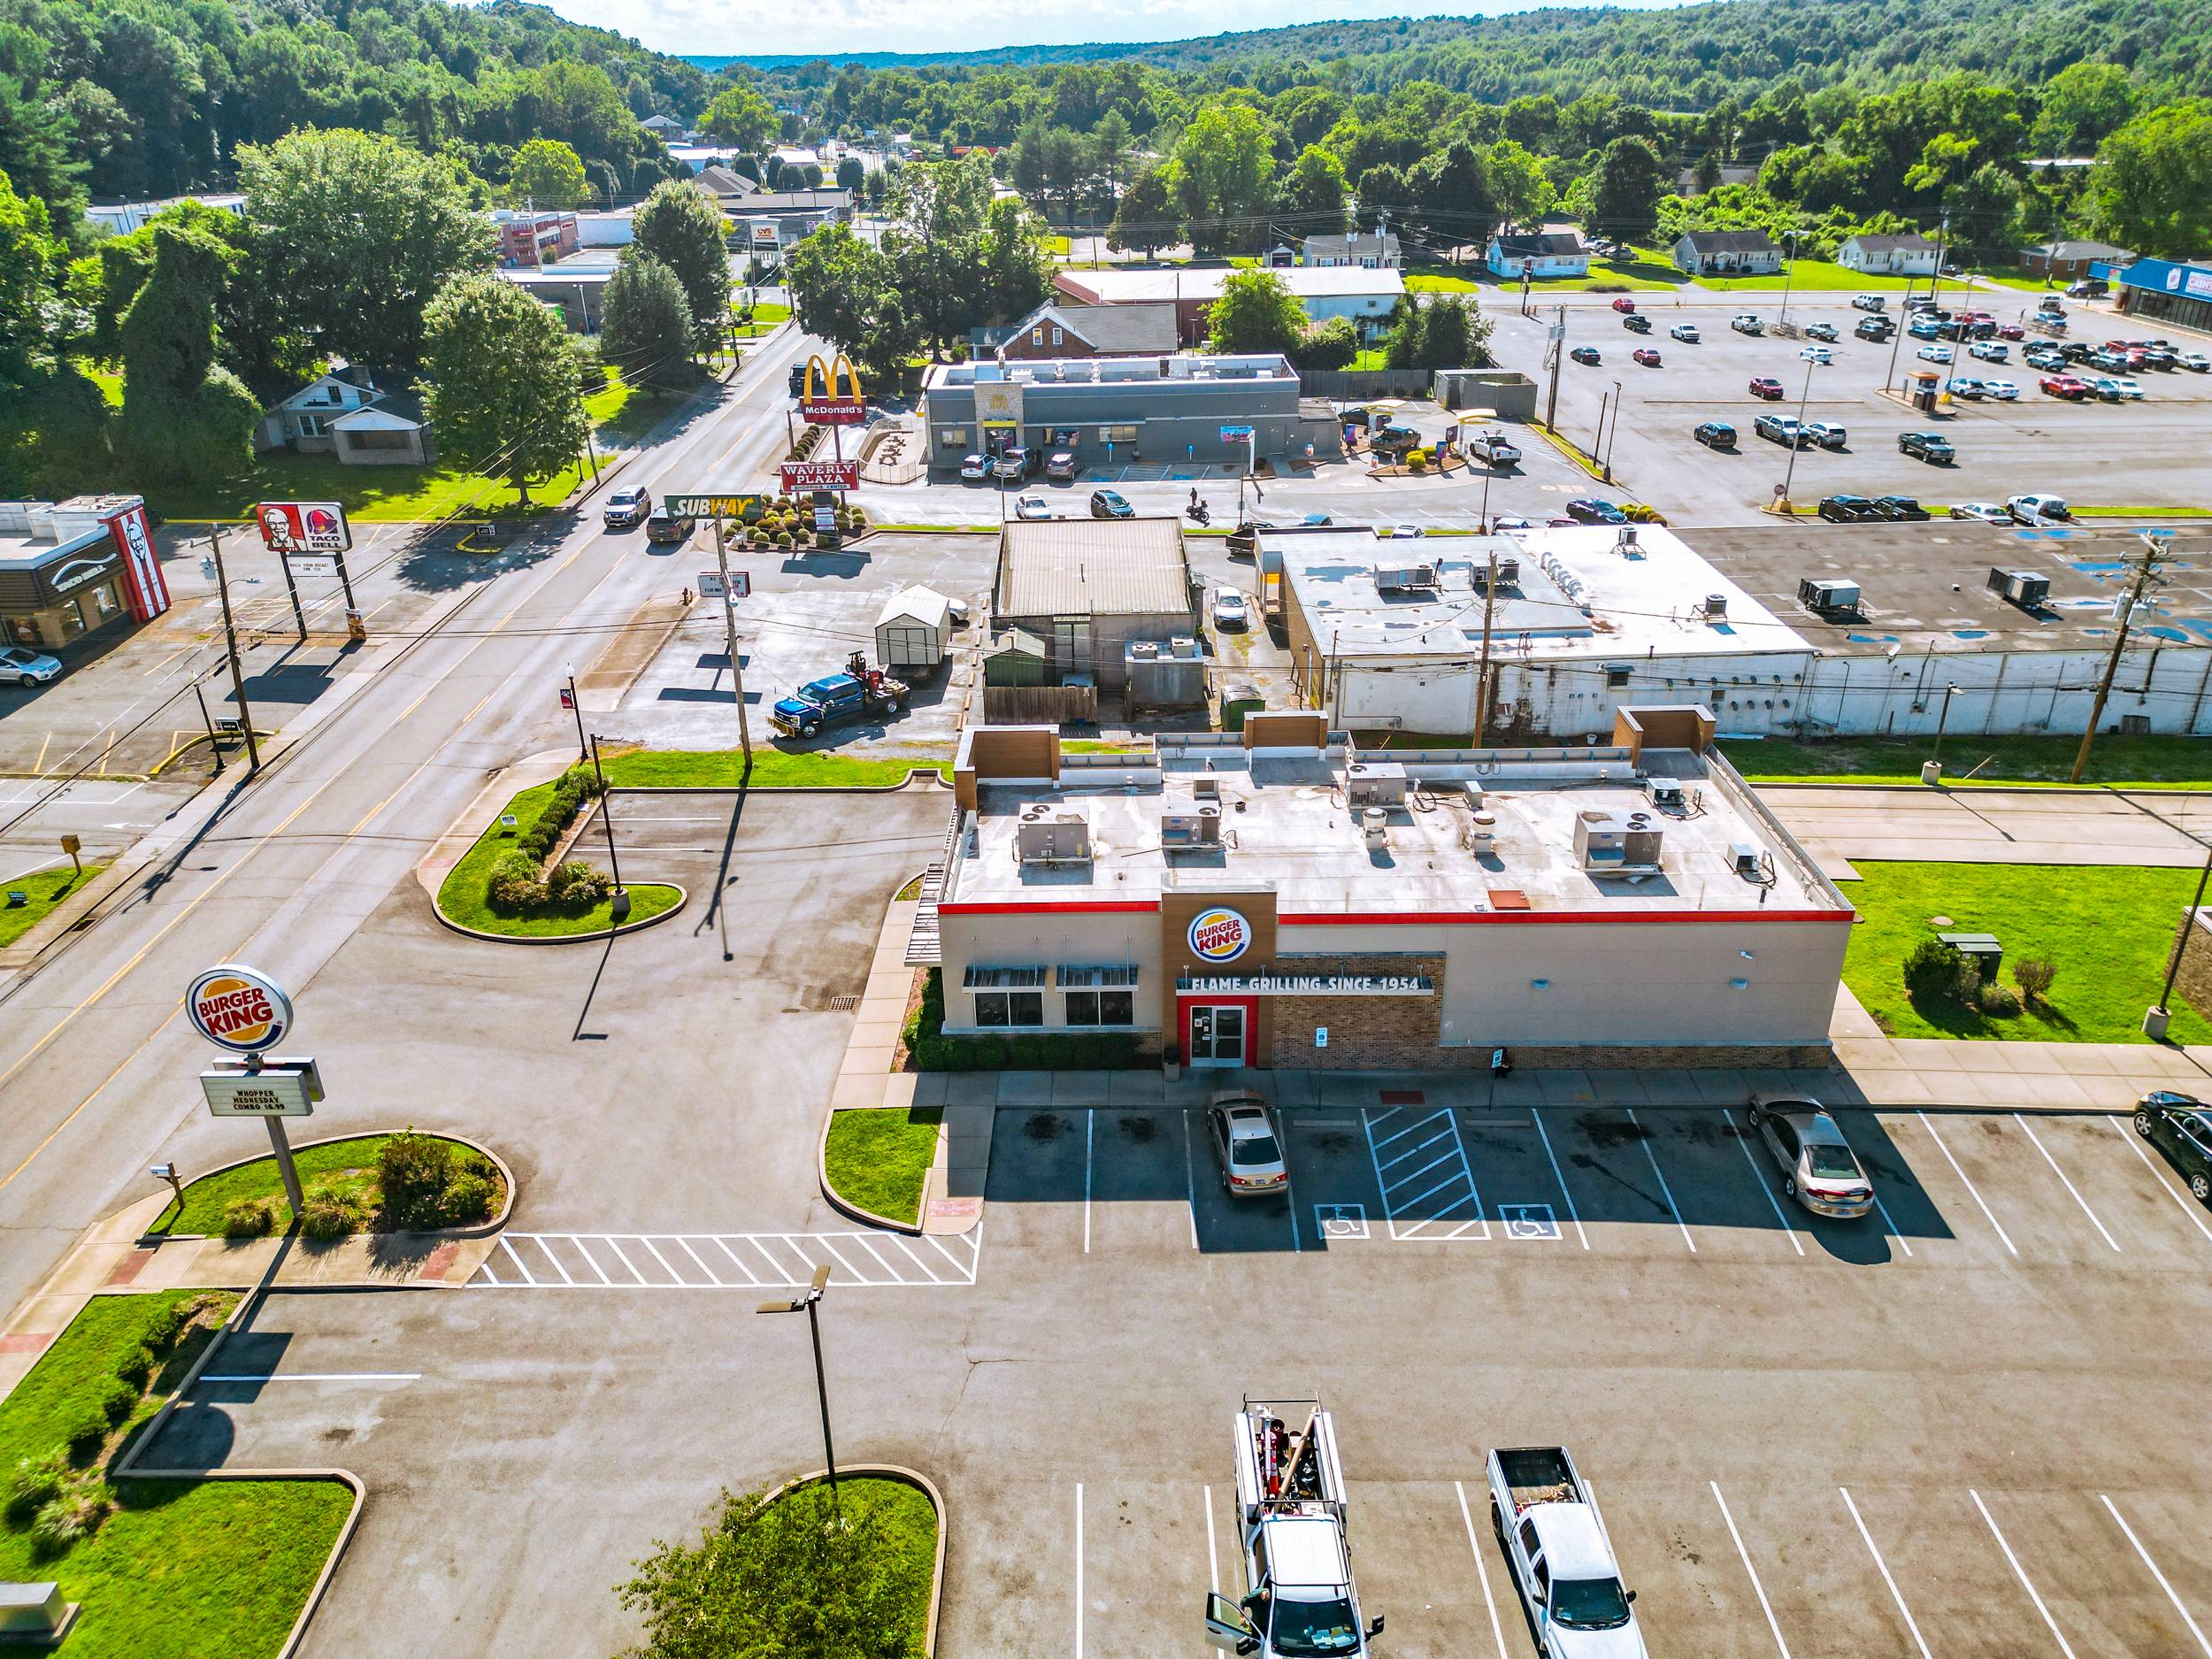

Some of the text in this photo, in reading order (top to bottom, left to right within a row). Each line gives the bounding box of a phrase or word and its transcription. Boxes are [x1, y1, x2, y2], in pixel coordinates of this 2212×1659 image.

[784, 465, 853, 475] WAVERLY
[796, 474, 844, 484] PLAZA
[672, 497, 754, 517] SUBWAY
[1196, 918, 1240, 941] BURGER
[1199, 927, 1242, 953] KING
[1192, 977, 1419, 992] FLAME GRILLING SINCE 1954
[197, 987, 265, 1018] BURGER
[205, 1002, 273, 1036] KING
